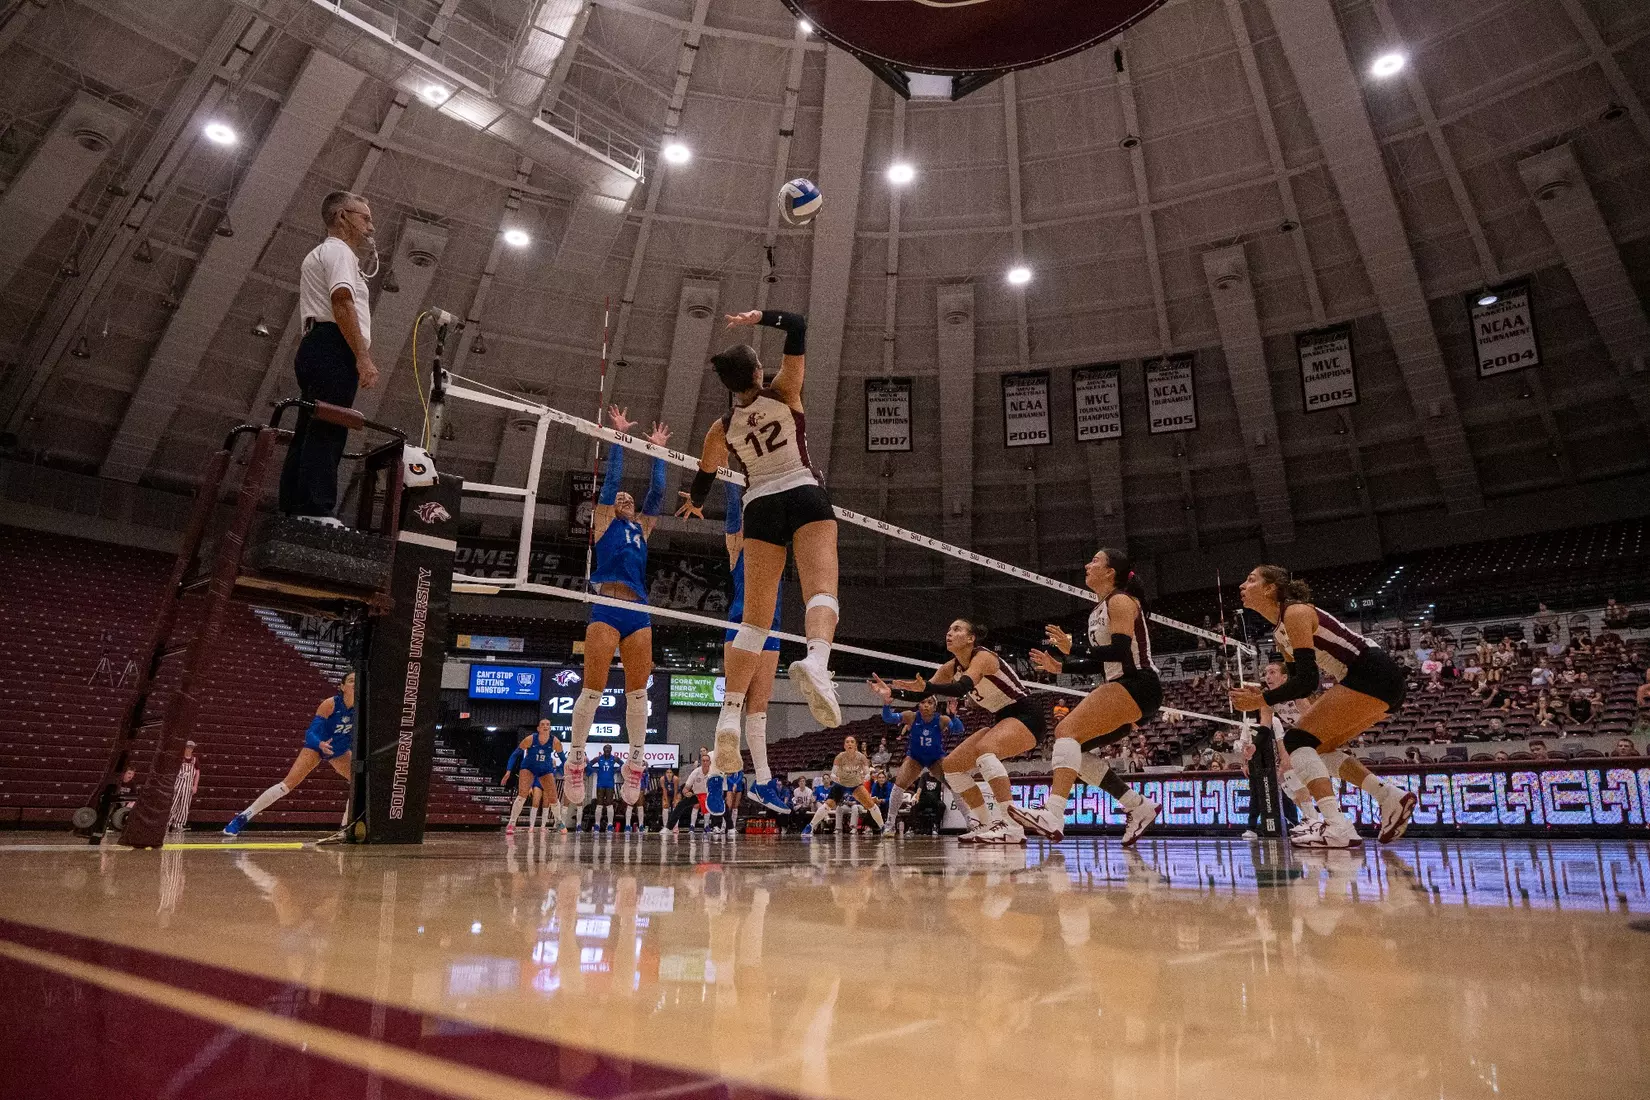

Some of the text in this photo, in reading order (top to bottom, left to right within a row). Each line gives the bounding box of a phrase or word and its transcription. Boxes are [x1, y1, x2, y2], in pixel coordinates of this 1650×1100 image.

[1481, 315, 1524, 335] NCAA
[1480, 328, 1530, 344] TOURNAMENT
[1302, 345, 1347, 358] BASKETBALL
[1312, 357, 1340, 372] MVC
[1483, 350, 1534, 370] 2004
[1306, 368, 1351, 382] CHAMPIONS
[1153, 384, 1188, 398] NCAA
[1309, 388, 1352, 404] 2005
[1010, 400, 1042, 411] NCAA
[1086, 394, 1110, 406] MVC
[1152, 395, 1191, 406] TOURNAMENT
[877, 406, 900, 416] MVC
[1080, 404, 1118, 414] TOURNAMENT
[1008, 412, 1046, 420] TOURNAMENT
[1078, 412, 1119, 422] CHAMPIONS
[1153, 414, 1193, 428] 2005
[1010, 430, 1046, 440] 2006
[1080, 424, 1119, 435] 2006
[614, 432, 633, 444] SIU
[744, 420, 788, 458] 12
[872, 436, 908, 445] 2007
[668, 450, 684, 462] SIU
[718, 466, 733, 478] SIU
[842, 510, 855, 519] SIU
[878, 522, 890, 530] SIU
[910, 533, 922, 542] SIU
[942, 544, 952, 552] SIU
[476, 670, 496, 678] CAN'T
[476, 678, 504, 686] BETTING
[390, 566, 432, 820] SOUTHERN ILLINOIS UNIVERSITY
[476, 686, 510, 694] NONSTOP?
[549, 696, 574, 714] 12
[602, 697, 610, 705] 3
[334, 724, 353, 734] 22
[562, 731, 566, 740] 1
[920, 736, 932, 746] 12
